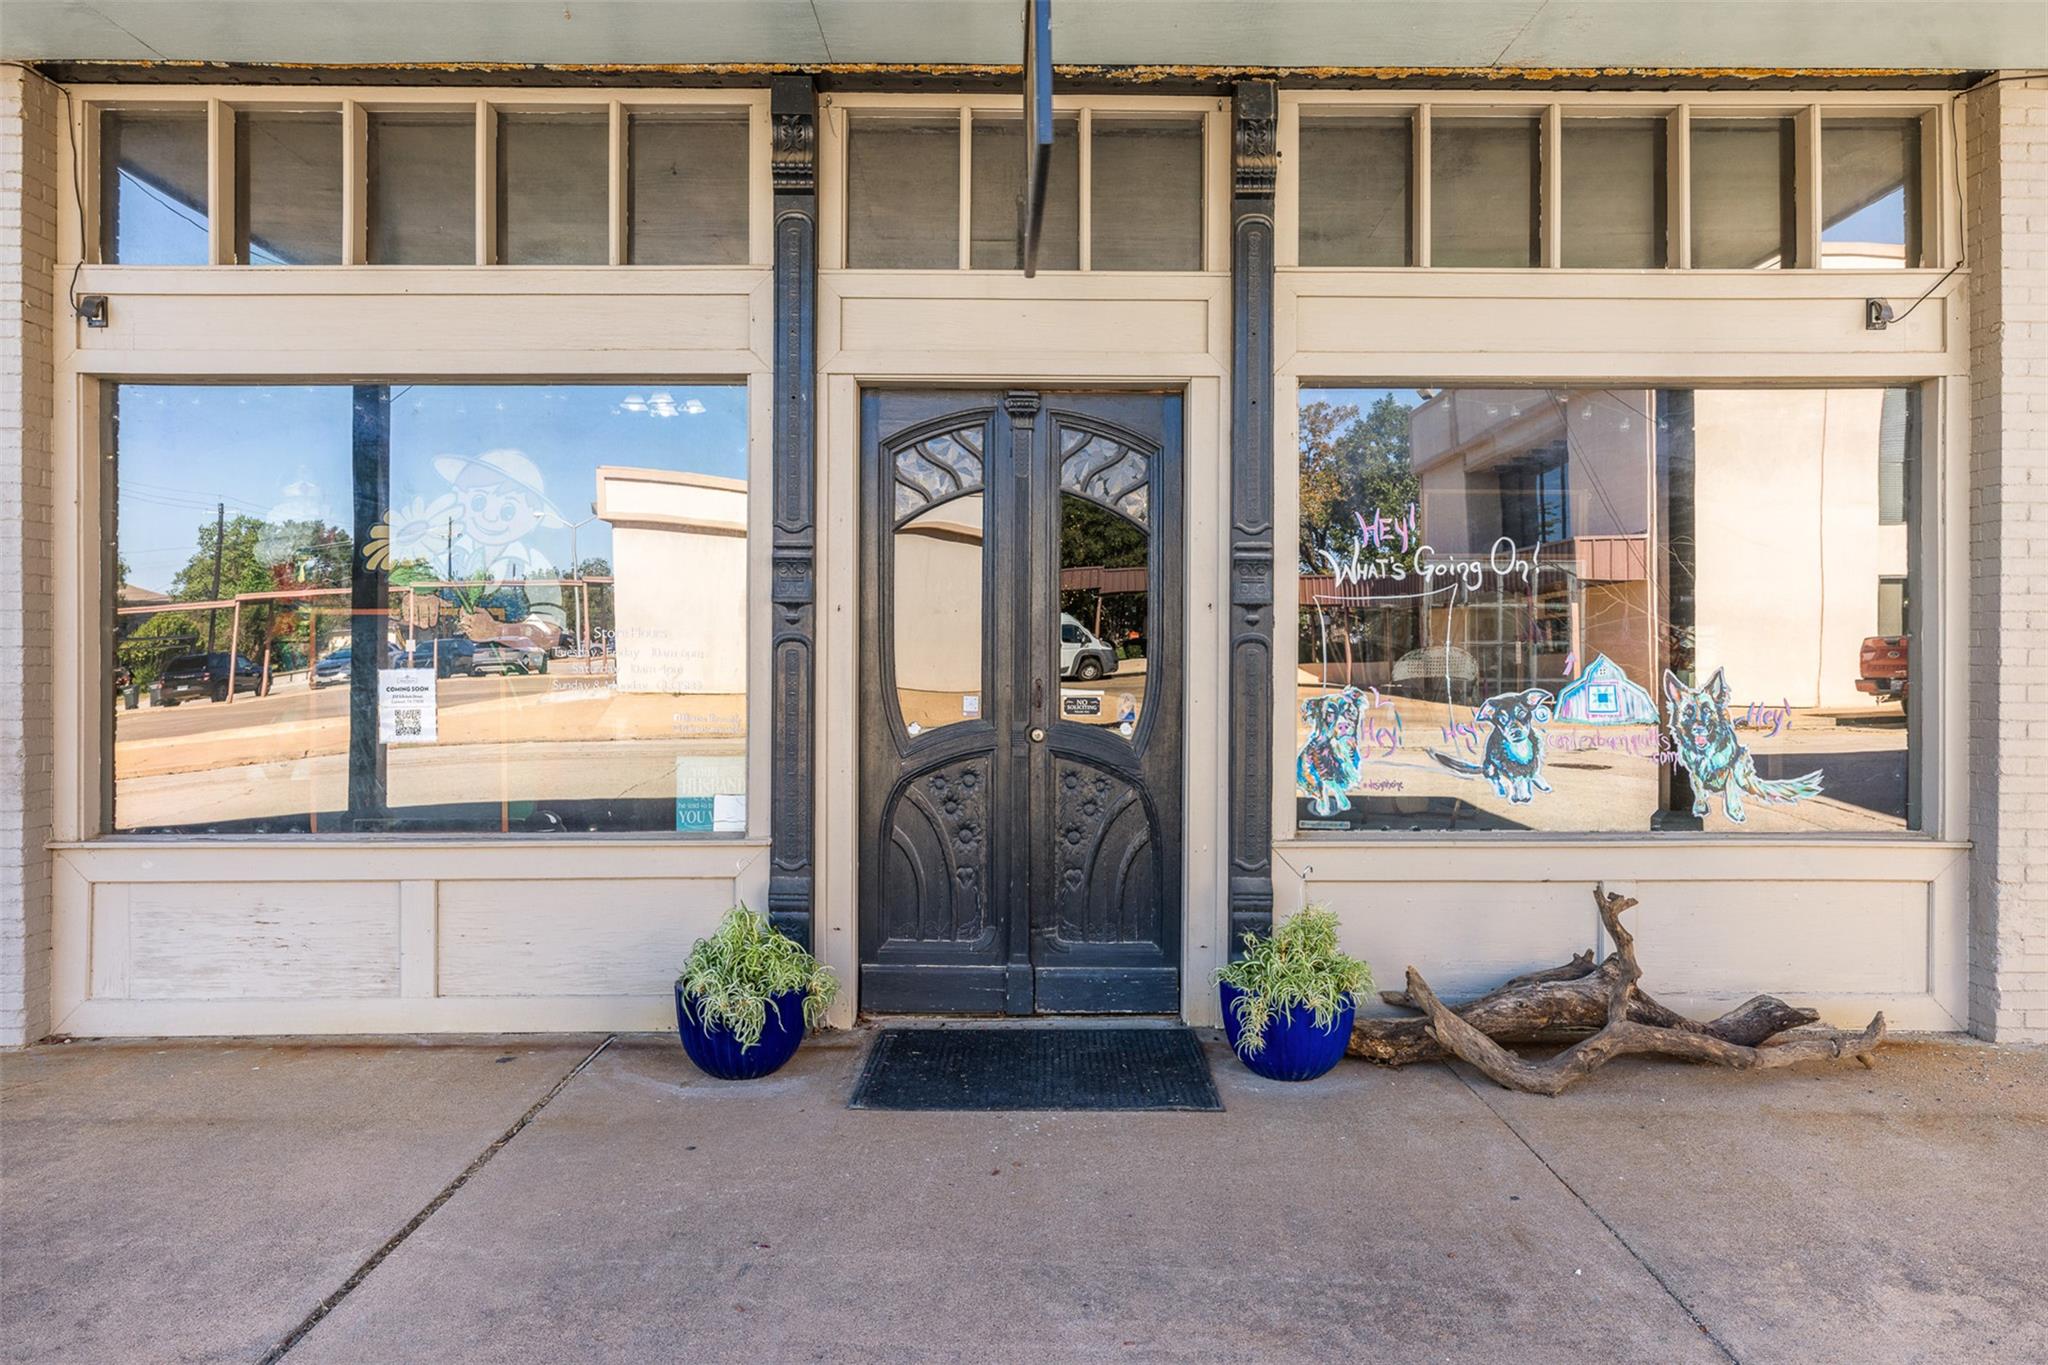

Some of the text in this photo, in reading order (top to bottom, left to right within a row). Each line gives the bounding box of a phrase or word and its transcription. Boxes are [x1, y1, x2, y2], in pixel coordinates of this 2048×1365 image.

[1354, 502, 1416, 554] HEY!
[1414, 545, 1482, 591] Going
[1490, 536, 1541, 584] On!
[593, 626, 628, 639] Store
[553, 680, 591, 691] Sunday
[1747, 697, 1792, 738] Hey!
[679, 810, 706, 824] YOU
